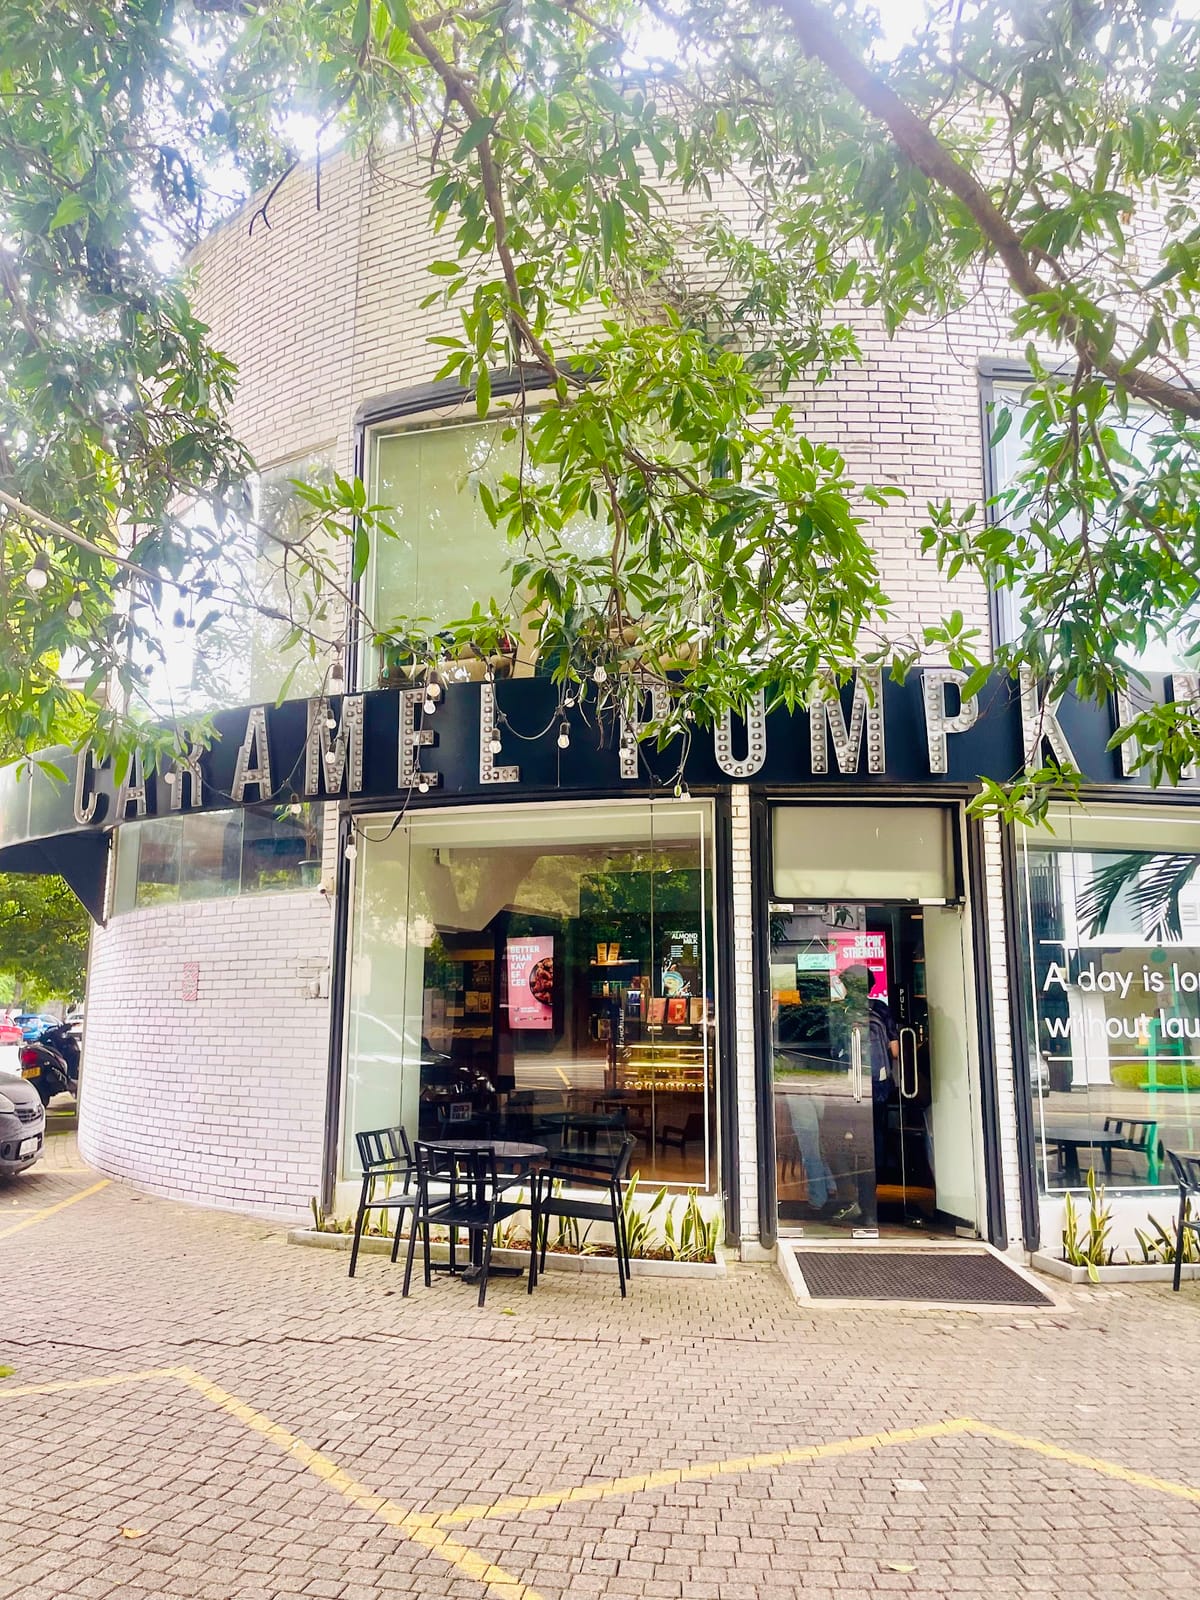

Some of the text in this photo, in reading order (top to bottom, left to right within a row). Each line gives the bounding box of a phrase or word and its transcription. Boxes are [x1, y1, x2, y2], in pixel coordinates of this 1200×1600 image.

[73, 683, 520, 824] CARAMEL
[510, 945, 540, 953] BETTER
[843, 947, 884, 958] STRENGTH
[511, 962, 526, 970] KAY
[1043, 962, 1200, 999] A day is lo
[1045, 1008, 1153, 1038] without
